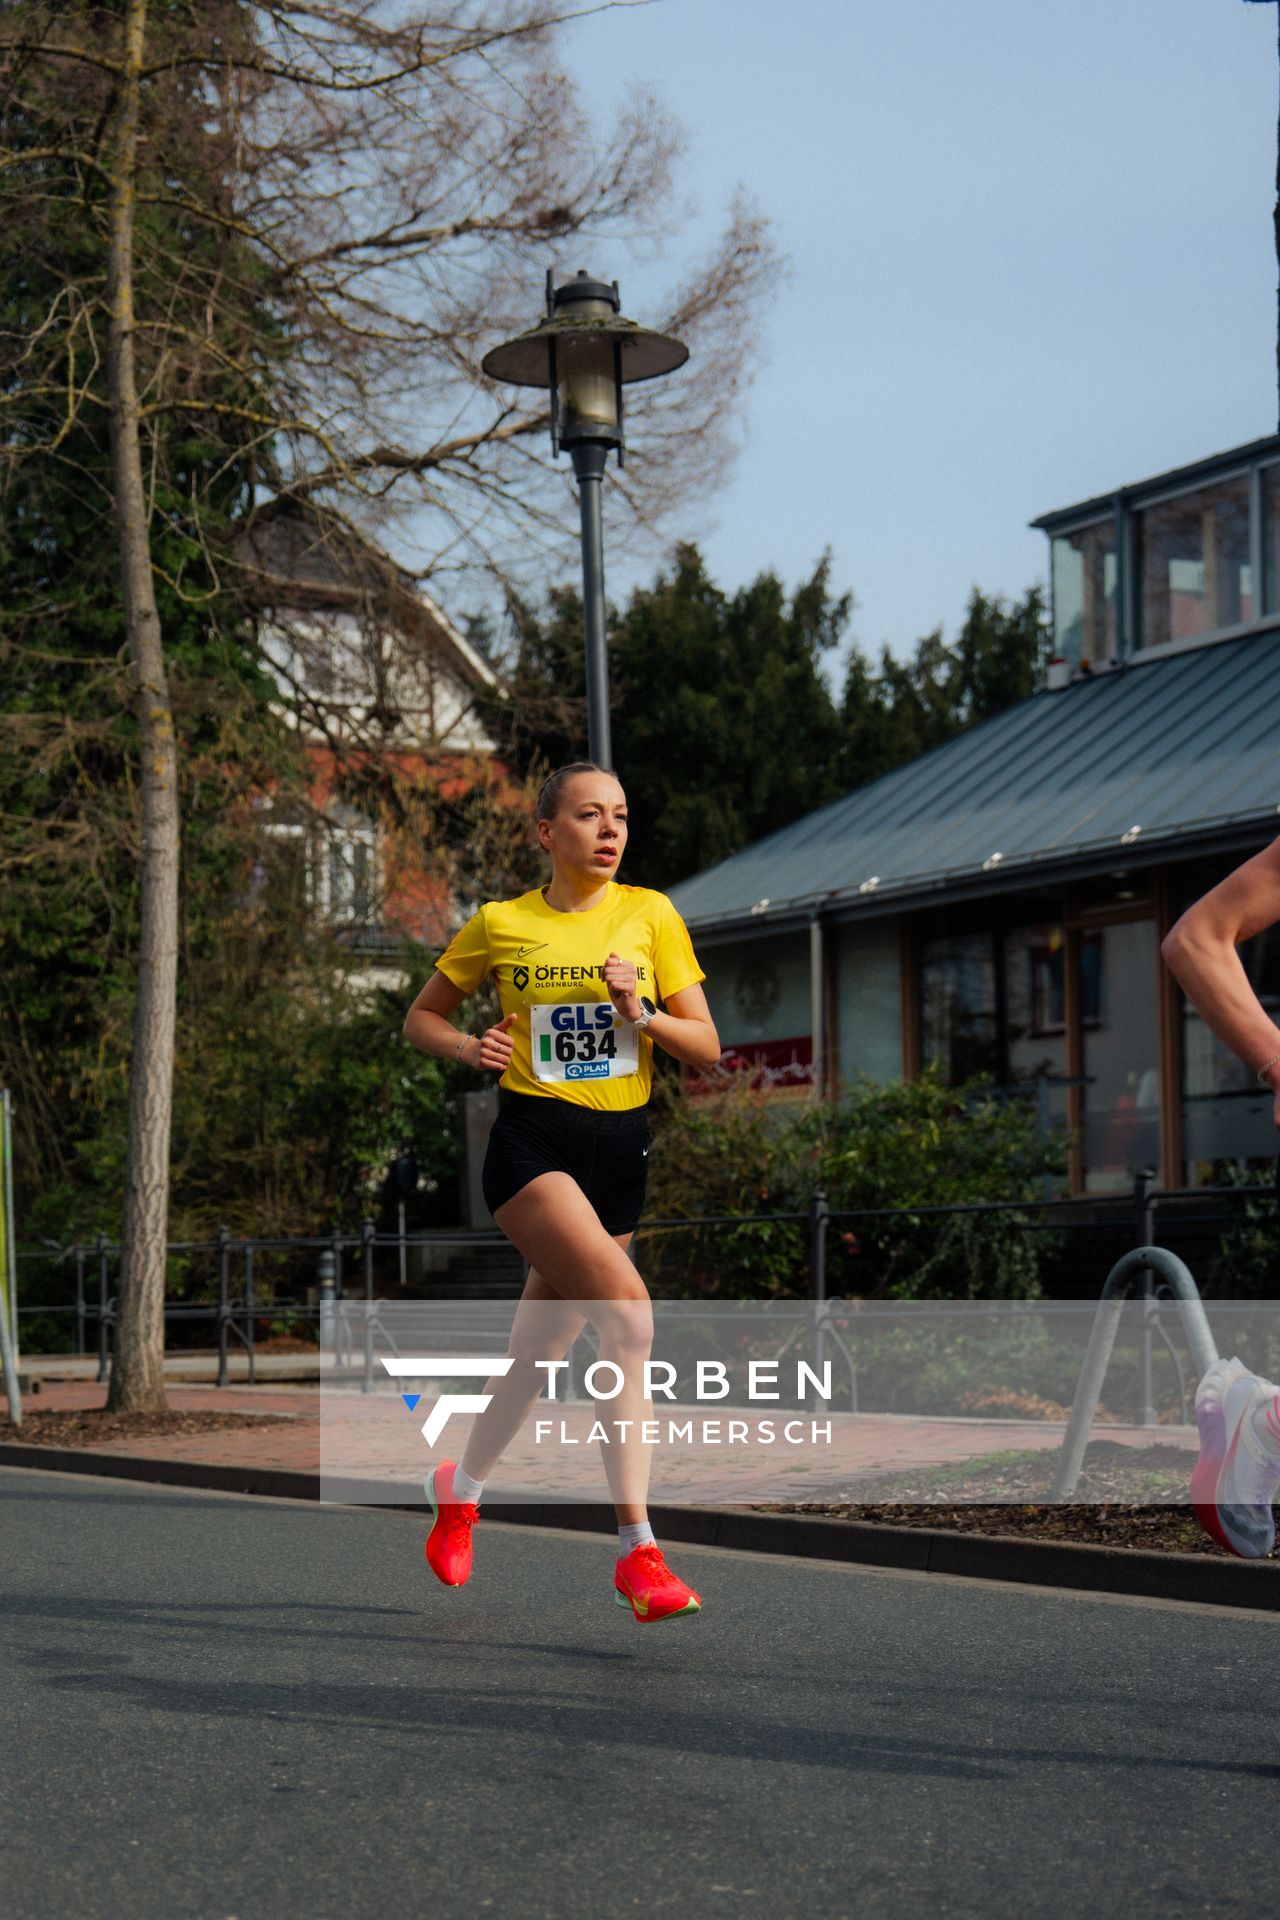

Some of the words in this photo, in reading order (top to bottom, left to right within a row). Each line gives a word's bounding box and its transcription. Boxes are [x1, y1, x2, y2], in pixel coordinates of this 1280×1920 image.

[535, 965, 646, 981] ÖFFENTE
[555, 1030, 617, 1063] 634
[583, 1063, 608, 1073] PLAN
